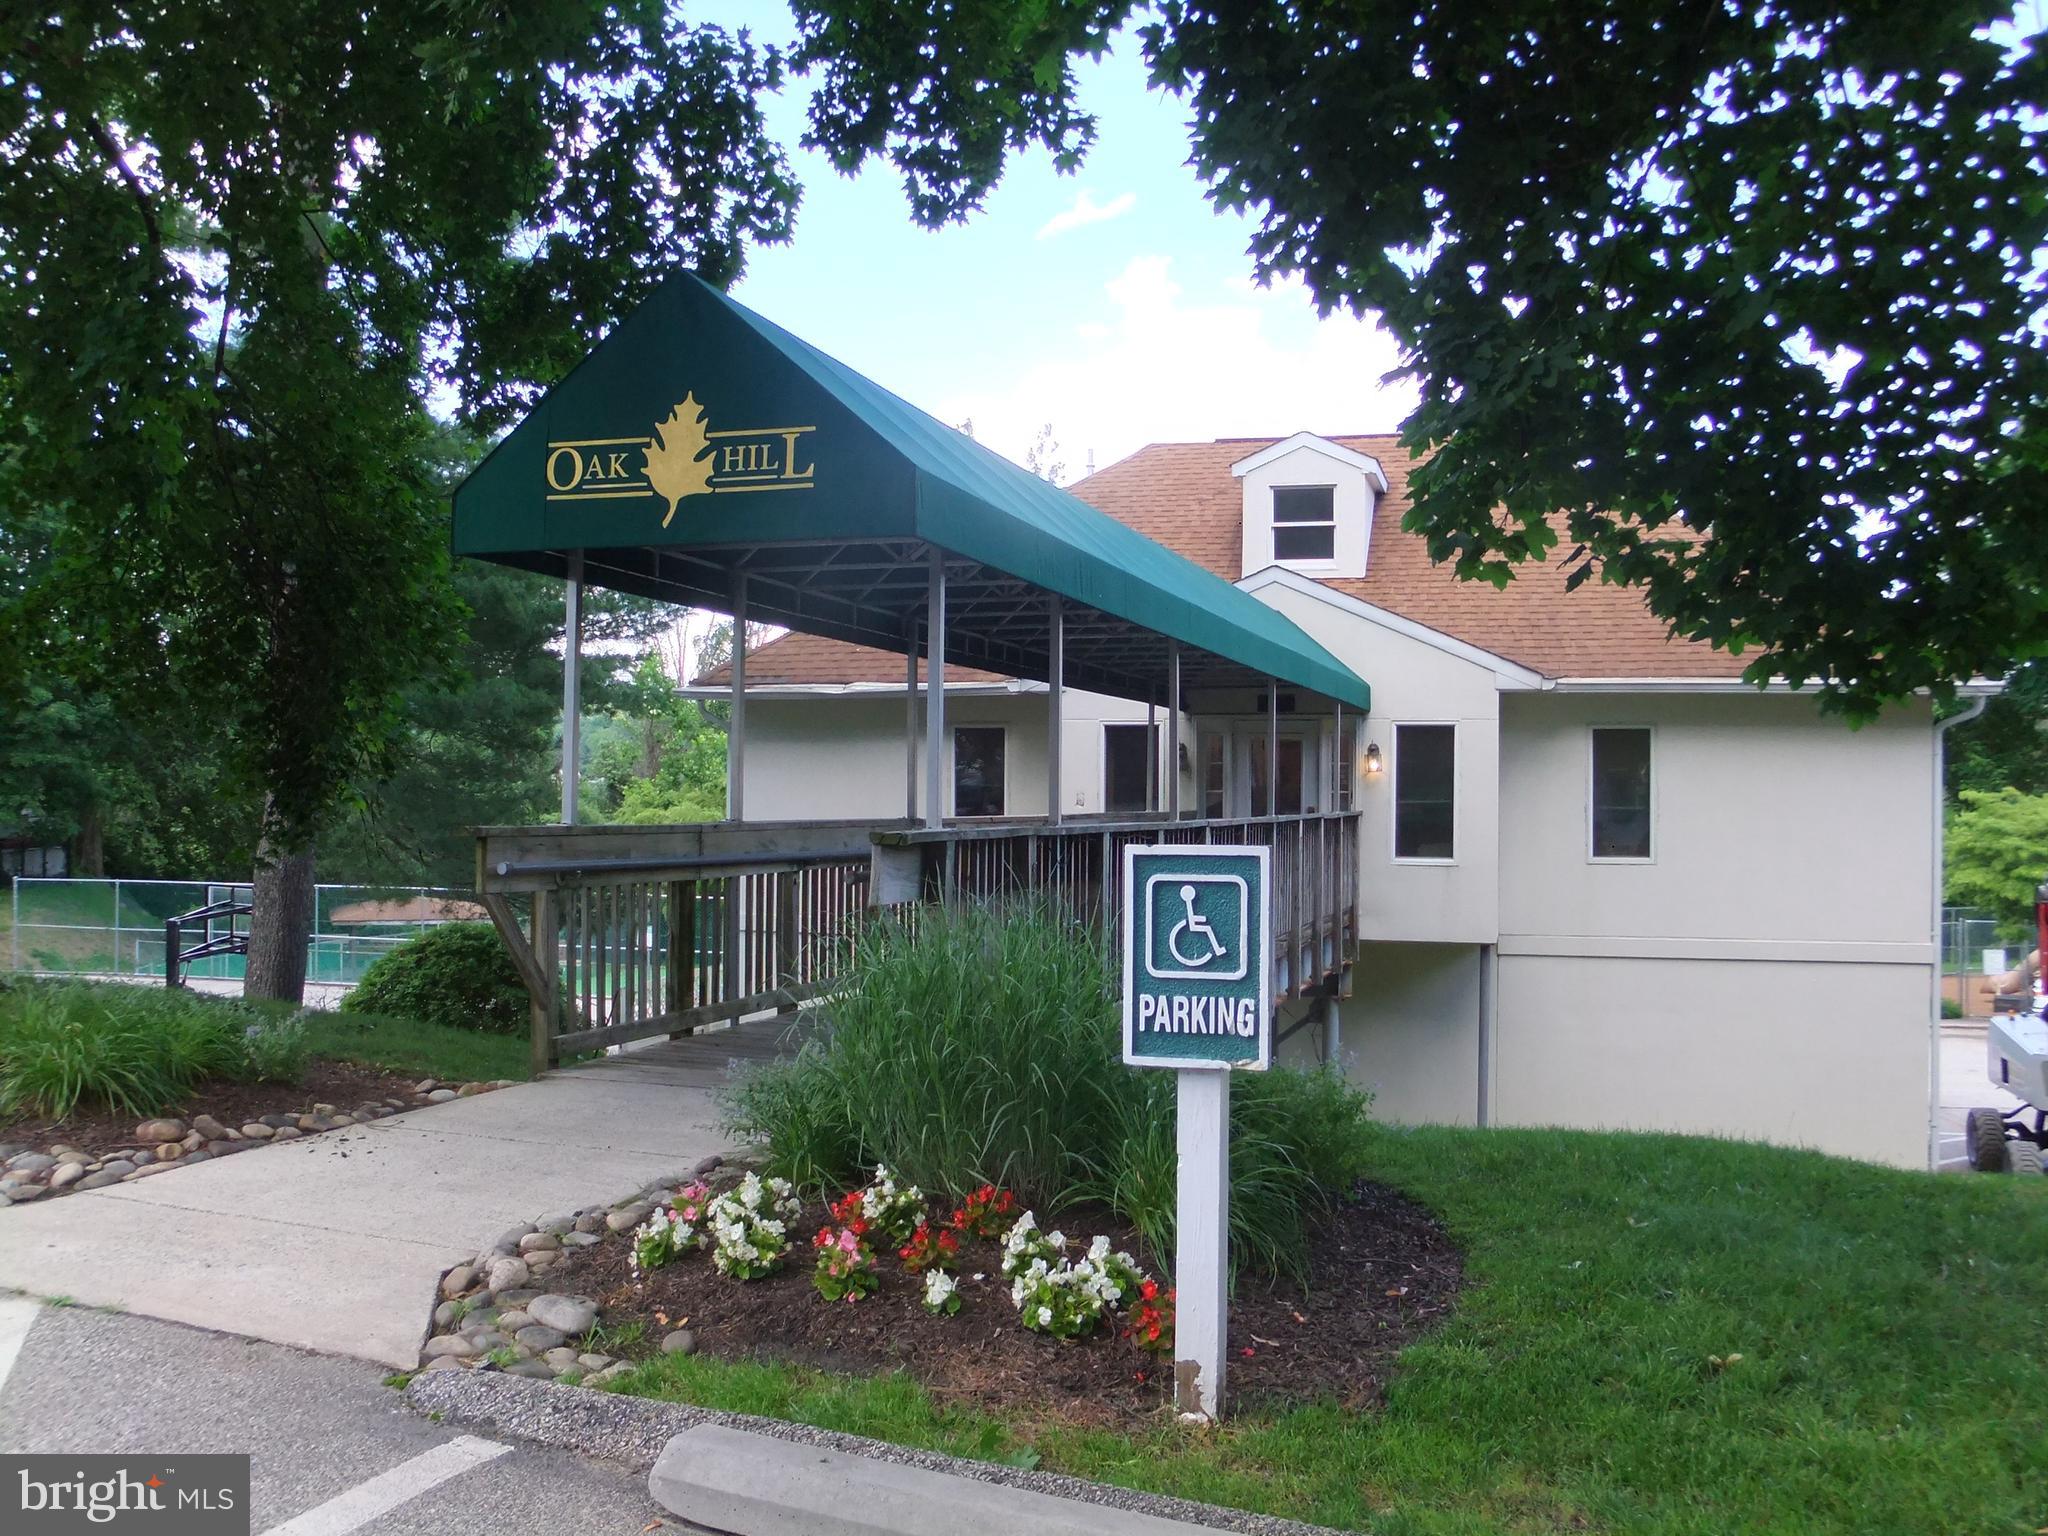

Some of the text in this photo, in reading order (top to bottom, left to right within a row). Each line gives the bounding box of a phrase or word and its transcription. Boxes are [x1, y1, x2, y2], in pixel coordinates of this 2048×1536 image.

[546, 432, 815, 492] OAK HILL
[1139, 993, 1256, 1038] PARKING
